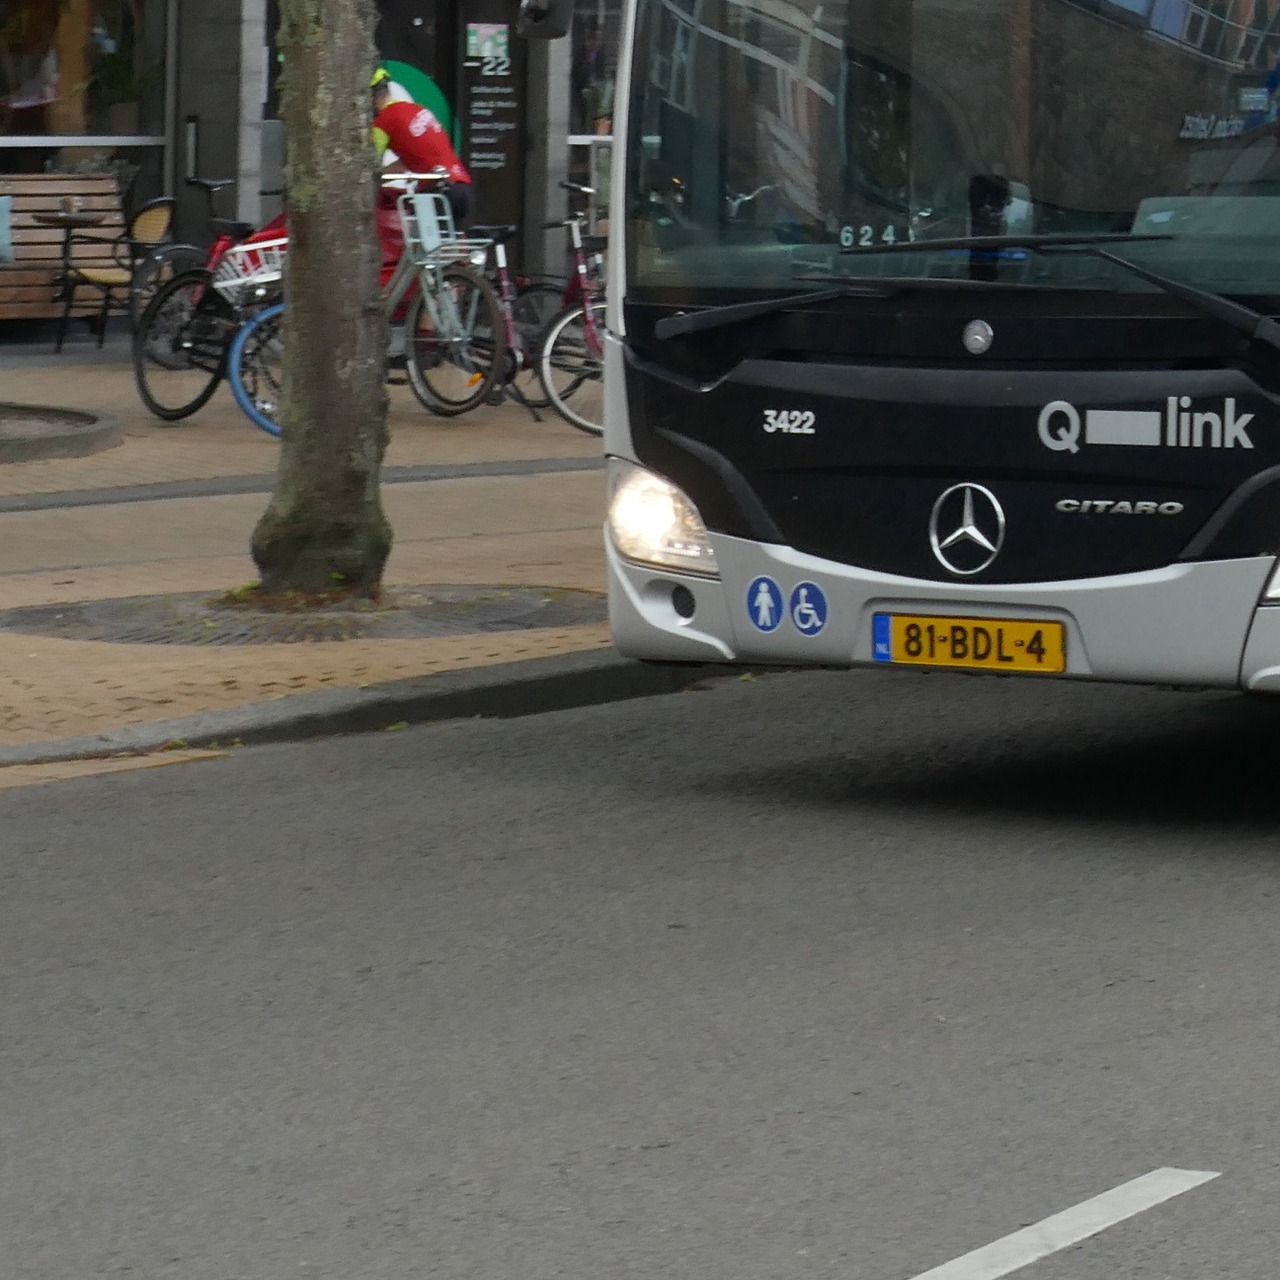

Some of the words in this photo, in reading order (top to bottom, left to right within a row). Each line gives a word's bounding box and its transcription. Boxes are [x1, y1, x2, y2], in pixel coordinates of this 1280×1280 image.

[482, 56, 511, 76] 22
[763, 410, 816, 434] 3422
[1037, 400, 1081, 454] Q
[1166, 396, 1255, 449] link
[1054, 498, 1185, 516] CITARO
[904, 623, 1047, 664] 81-BDL-4
